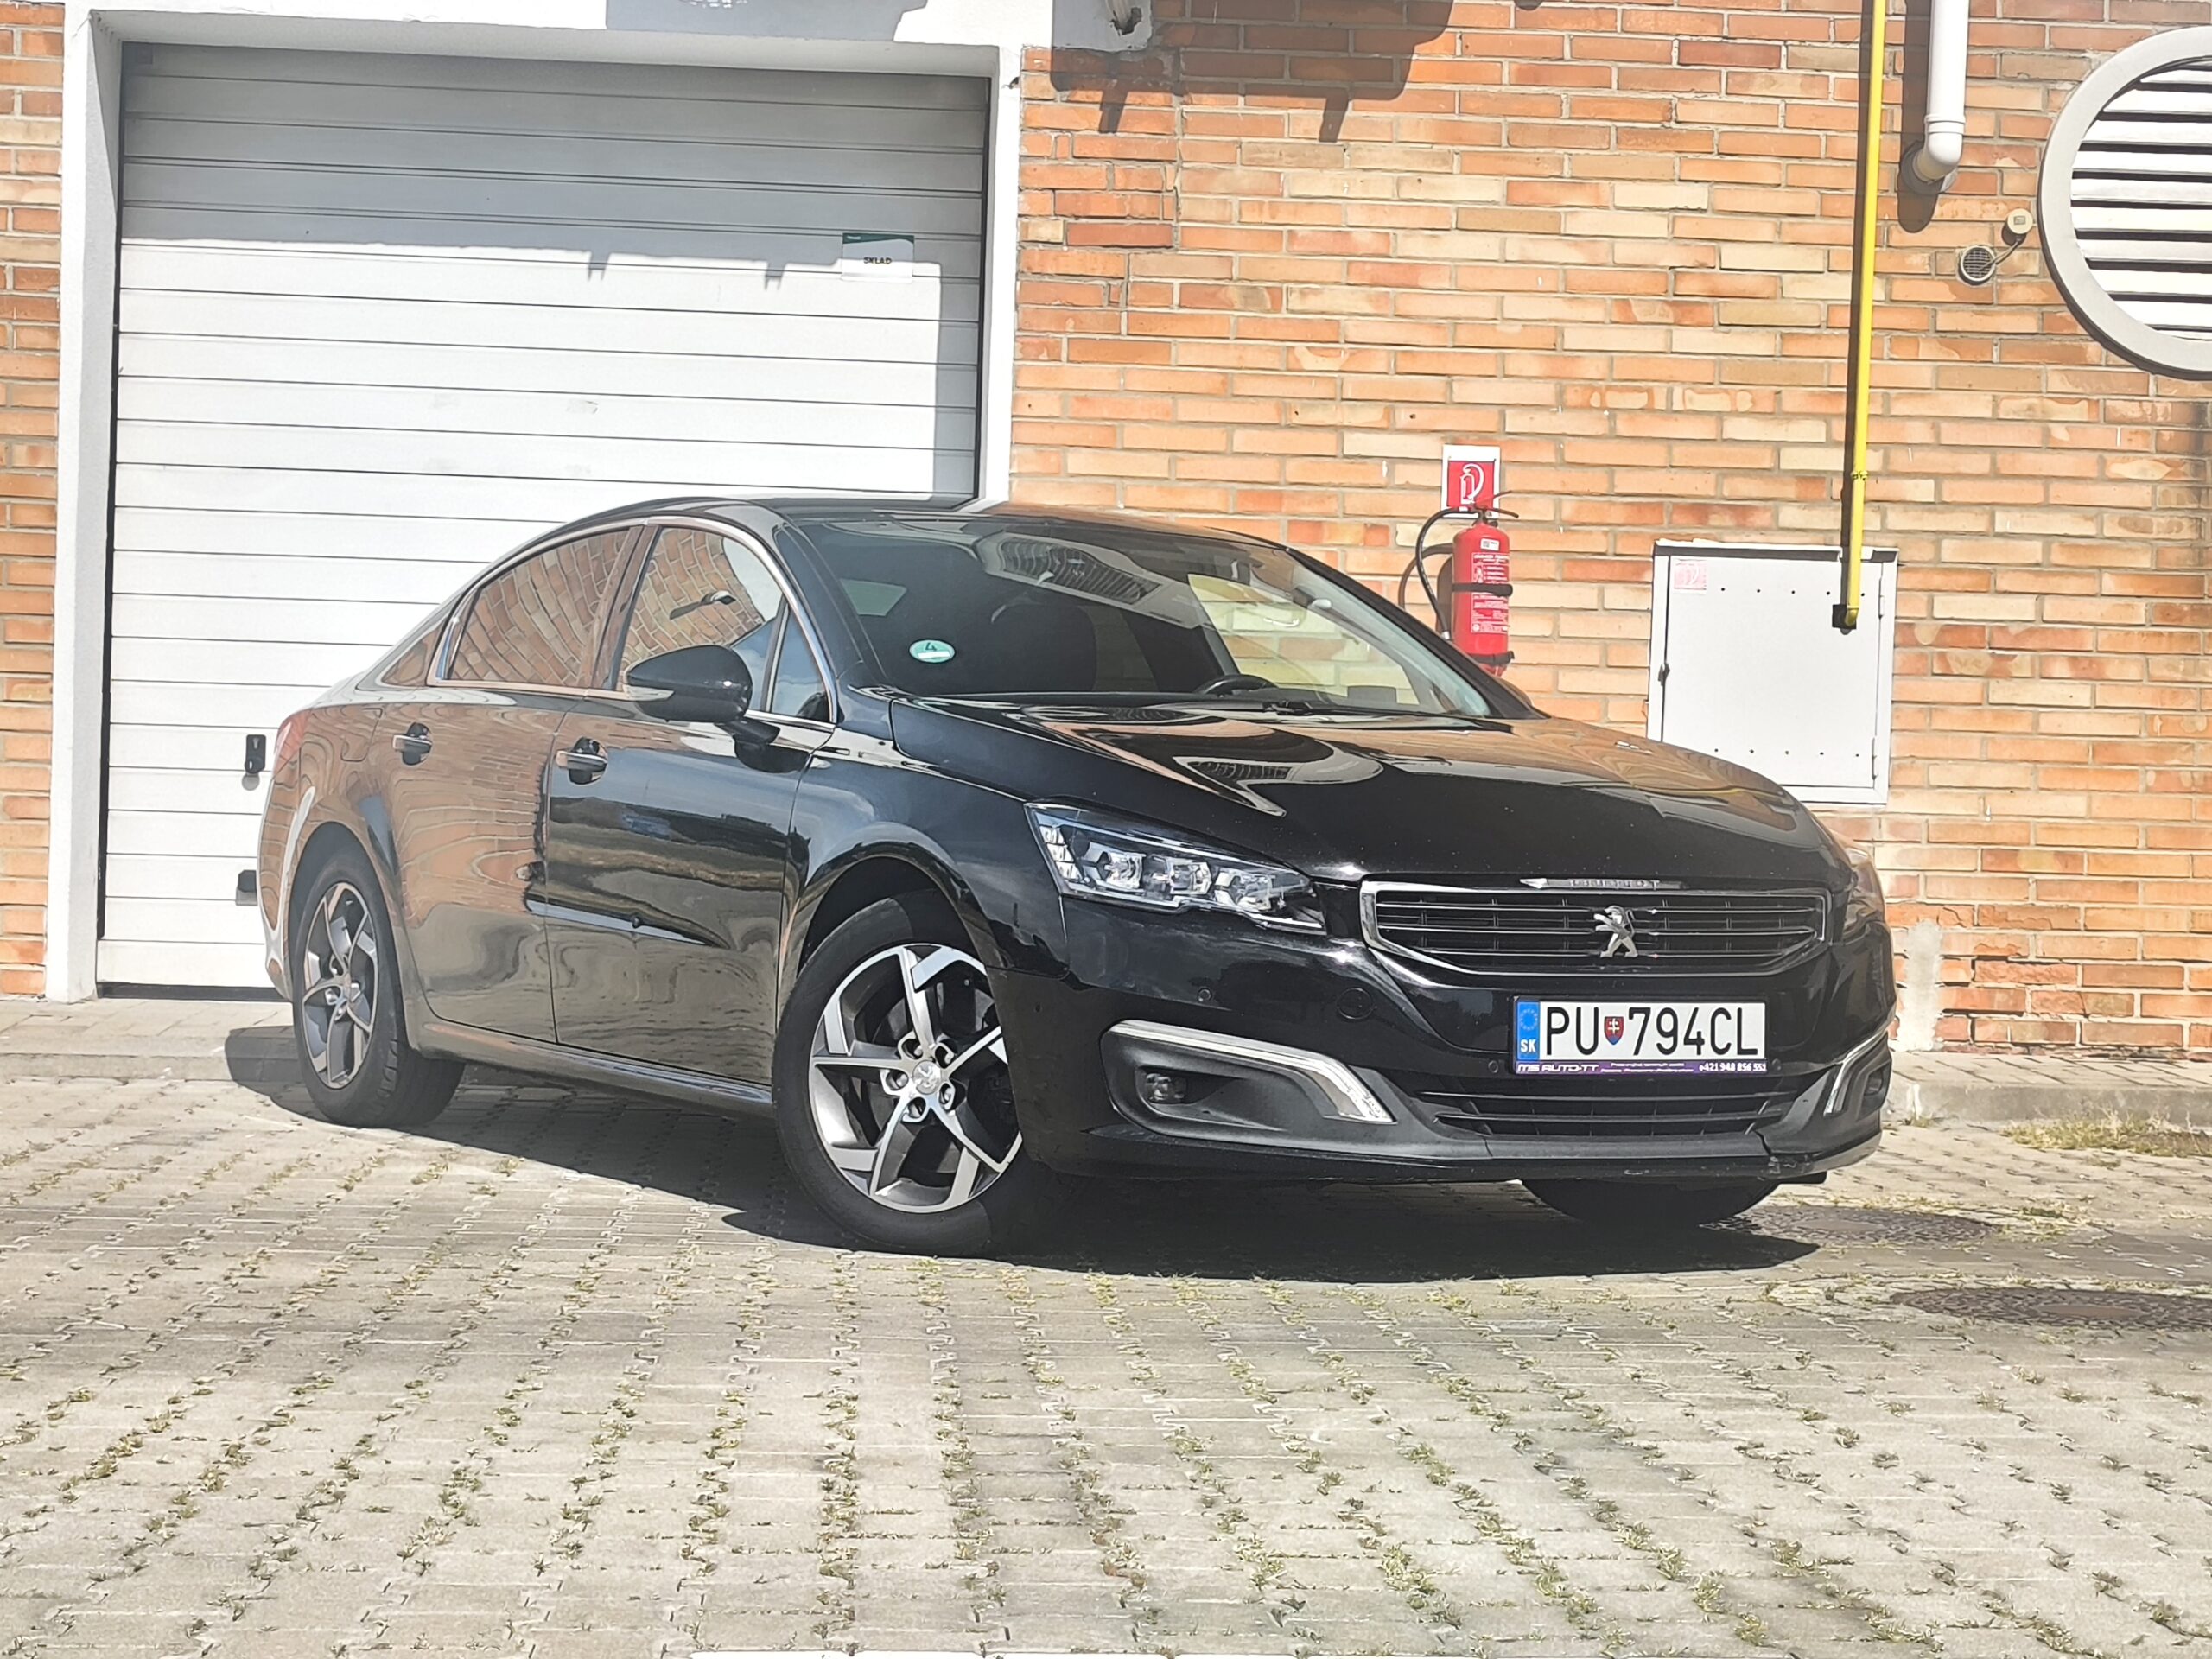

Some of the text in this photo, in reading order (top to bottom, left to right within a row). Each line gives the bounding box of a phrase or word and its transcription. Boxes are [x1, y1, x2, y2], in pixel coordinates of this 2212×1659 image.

[925, 642, 938, 651] 4
[1546, 1007, 1758, 1056] PU 794CL
[1520, 1039, 1536, 1052] SK
